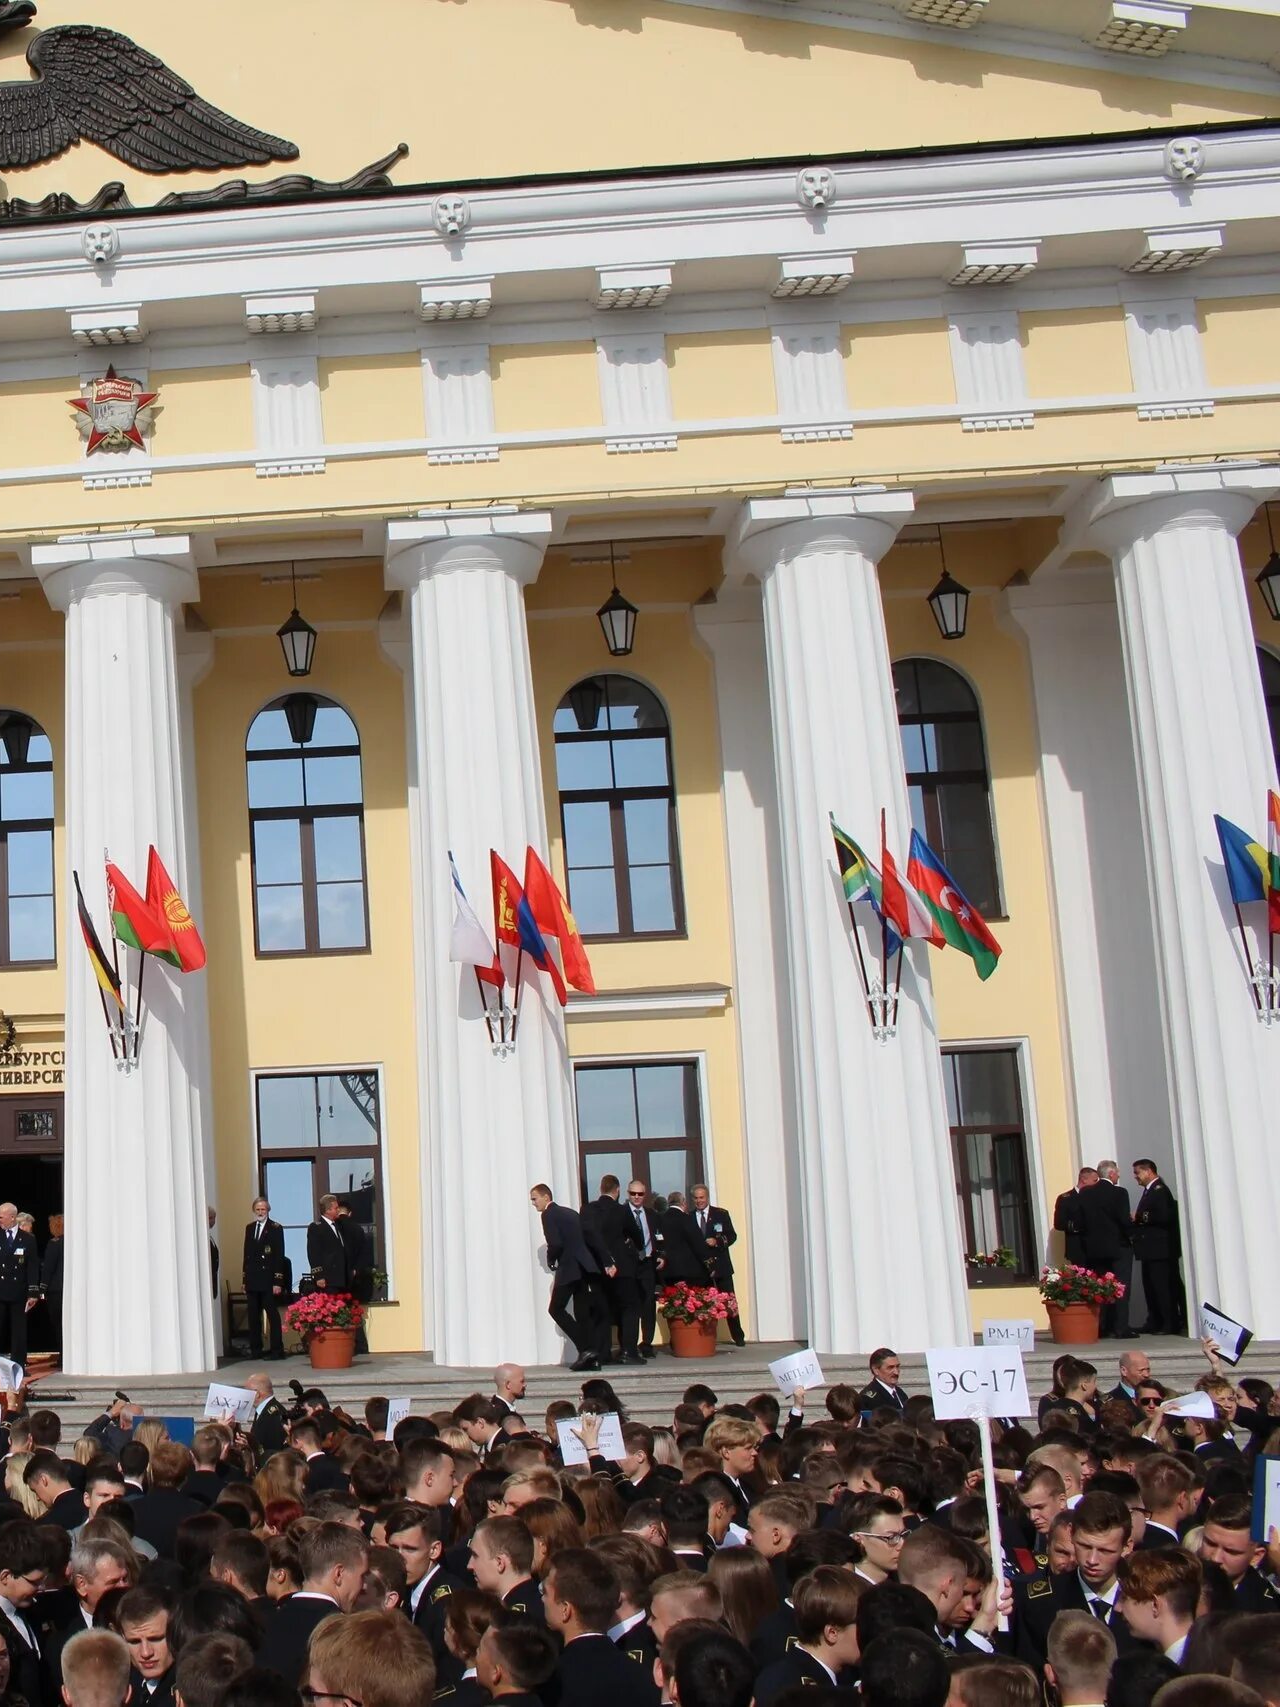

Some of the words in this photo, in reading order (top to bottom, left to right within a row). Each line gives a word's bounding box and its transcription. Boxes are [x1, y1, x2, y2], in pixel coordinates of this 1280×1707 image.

[988, 1327, 1030, 1339] РМ-17
[1204, 1319, 1230, 1337] РФ-17
[937, 1368, 1017, 1395] ЭС-17
[211, 1396, 250, 1410] АХ-17
